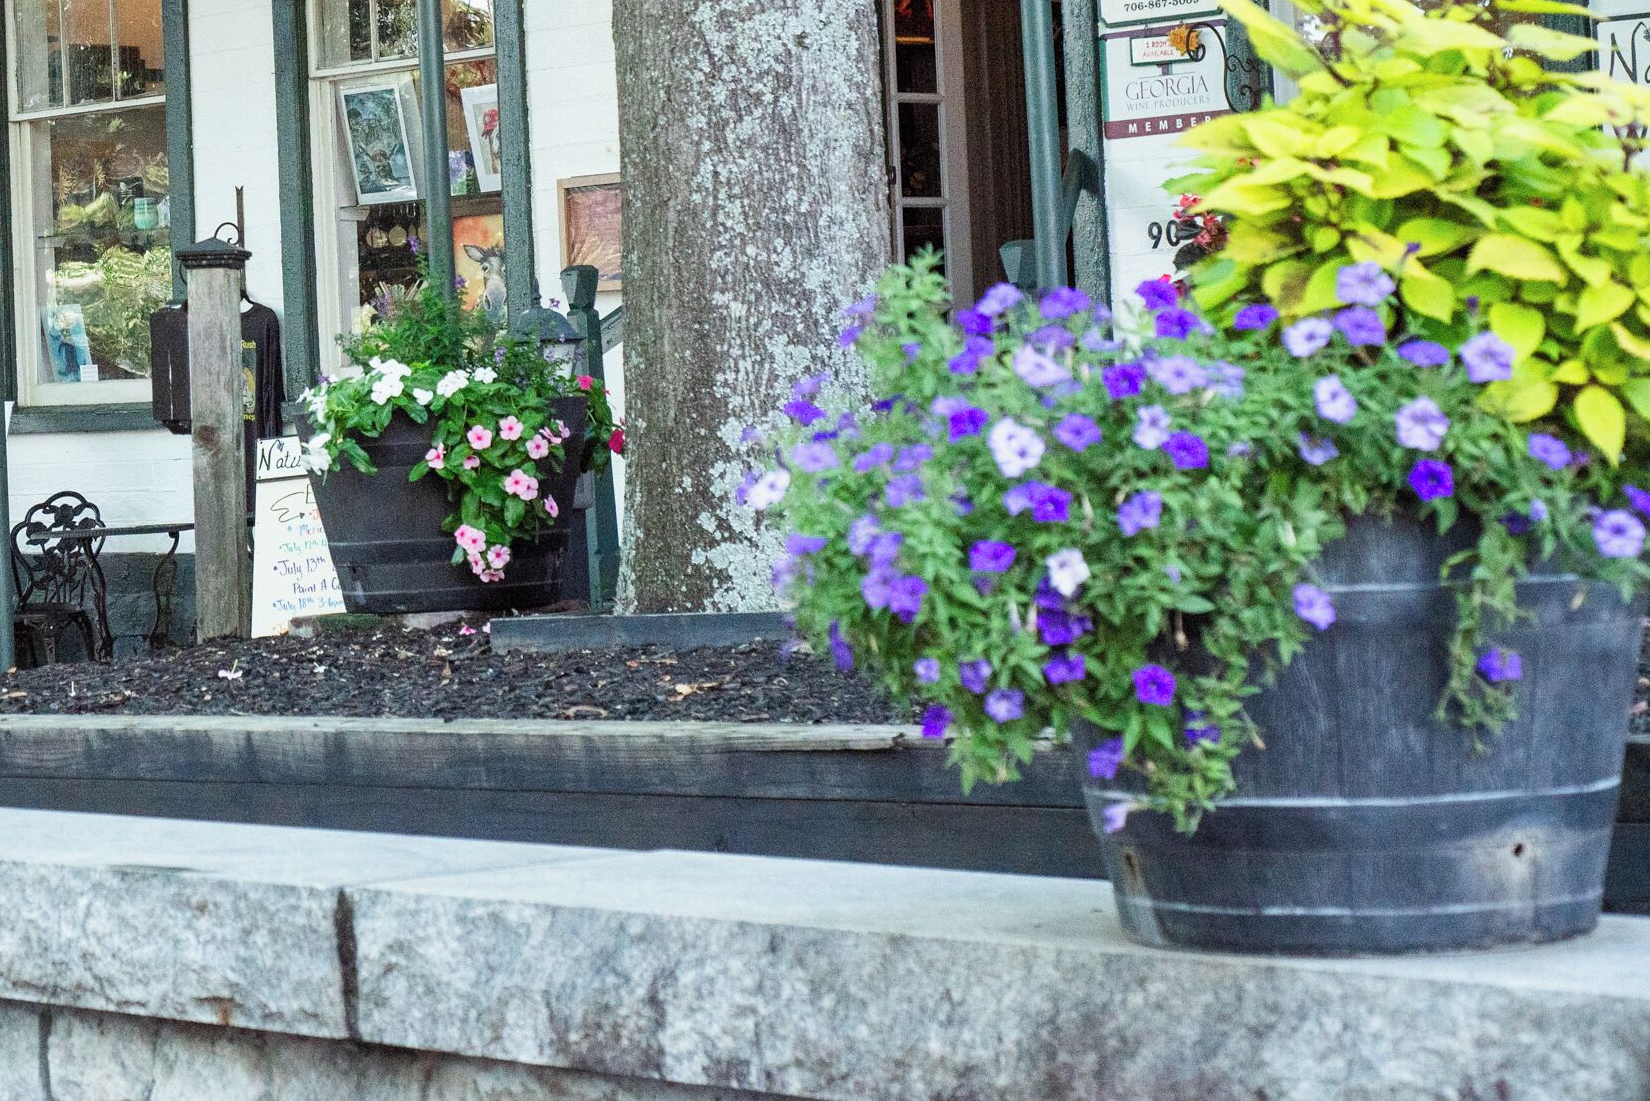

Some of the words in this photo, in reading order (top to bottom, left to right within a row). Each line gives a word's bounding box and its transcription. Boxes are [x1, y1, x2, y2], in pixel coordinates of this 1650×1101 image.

[1151, 40, 1167, 48] ROOM
[1142, 49, 1175, 58] AVAILABLE
[1125, 75, 1208, 100] GEORGIA
[1126, 101, 1152, 111] WINE
[1154, 96, 1211, 109] PRODUCERS
[258, 439, 302, 471] Natu
[277, 559, 303, 581] July
[306, 556, 326, 573] 13th
[293, 582, 316, 594] Paint
